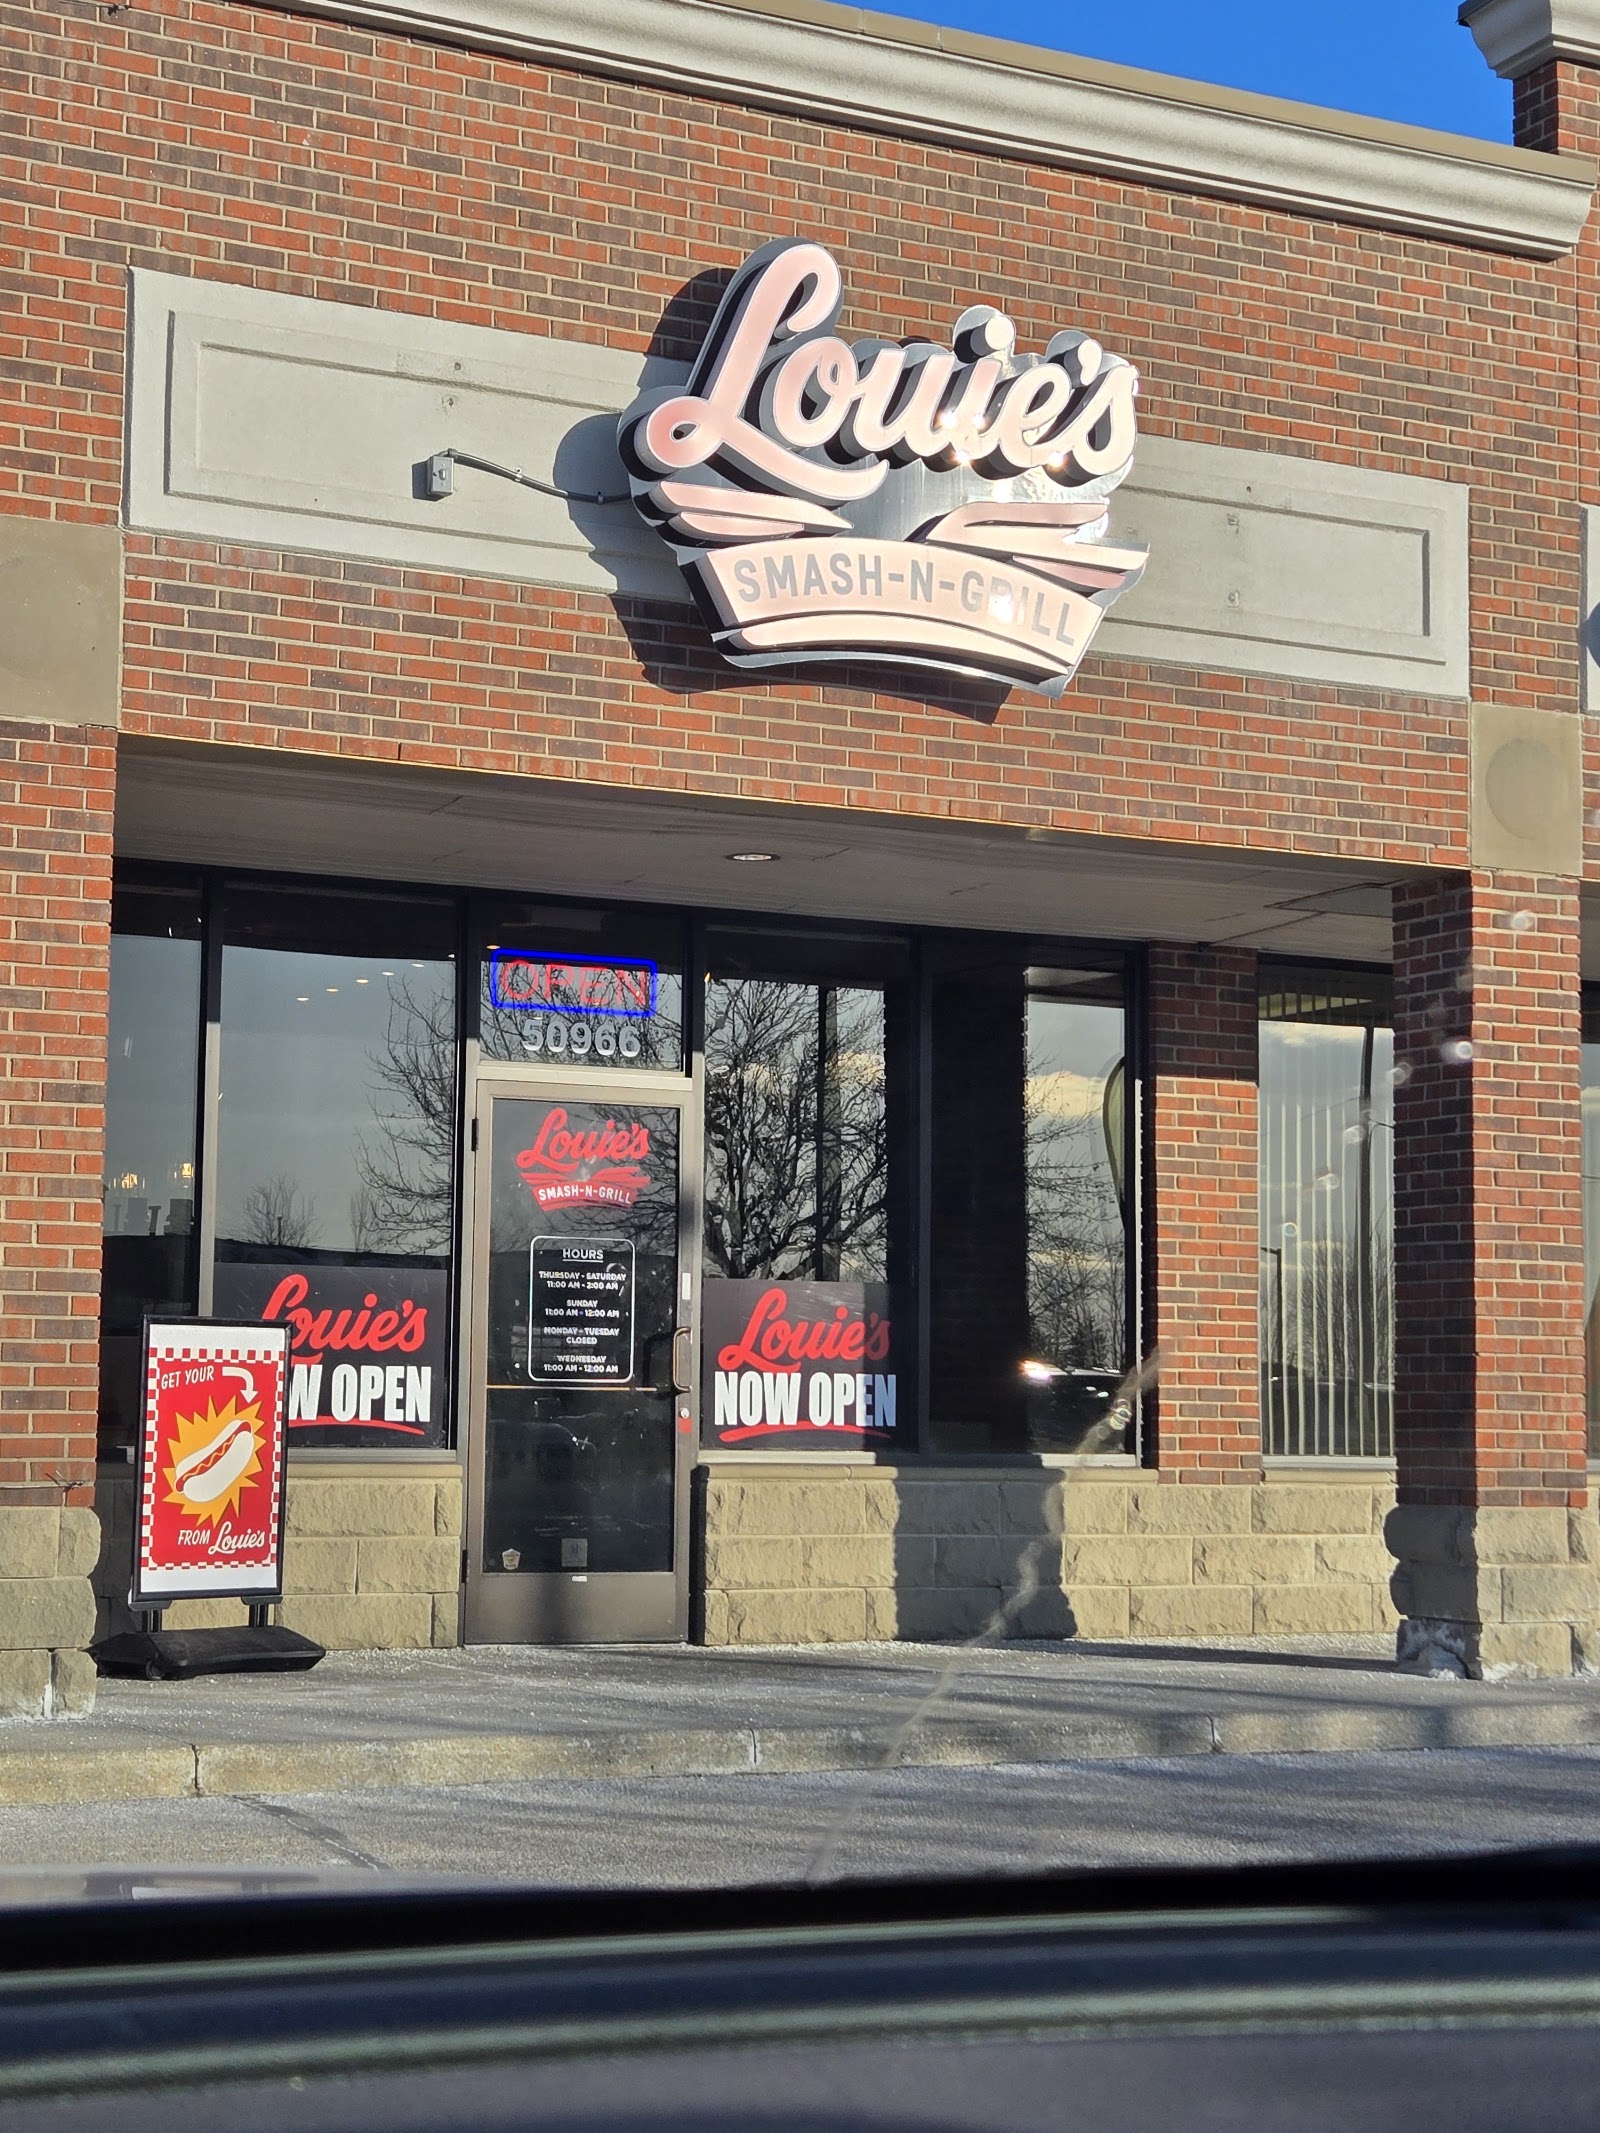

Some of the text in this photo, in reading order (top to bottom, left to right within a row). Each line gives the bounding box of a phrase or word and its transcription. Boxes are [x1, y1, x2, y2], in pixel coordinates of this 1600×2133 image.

[645, 243, 1140, 501] Louie's
[501, 958, 649, 1007] OPEN
[522, 1017, 642, 1058] 50966
[515, 1107, 650, 1173] Louie's
[538, 1184, 632, 1206] SMASH-N-GRILL
[562, 1248, 604, 1260] HOURS
[539, 1270, 580, 1280] THURSDAY
[586, 1272, 627, 1281] SATURDAY
[568, 1281, 580, 1289] AM
[605, 1282, 618, 1290] AM
[566, 1299, 598, 1308] SUNDAY
[566, 1308, 578, 1317] AM
[607, 1309, 620, 1318] AM
[543, 1326, 578, 1335] MONDAY
[584, 1327, 619, 1336] TUESDAY
[566, 1336, 598, 1345] CLOSED
[717, 1287, 892, 1373] Louie's
[556, 1355, 607, 1363] WEDNESDAY
[565, 1364, 577, 1372] AM
[605, 1365, 619, 1373] AM
[160, 1365, 215, 1390] GET YOUR
[331, 1363, 432, 1423] OPEN
[714, 1371, 897, 1427] NOW OPEN
[177, 1520, 266, 1555] FROM Louie's
